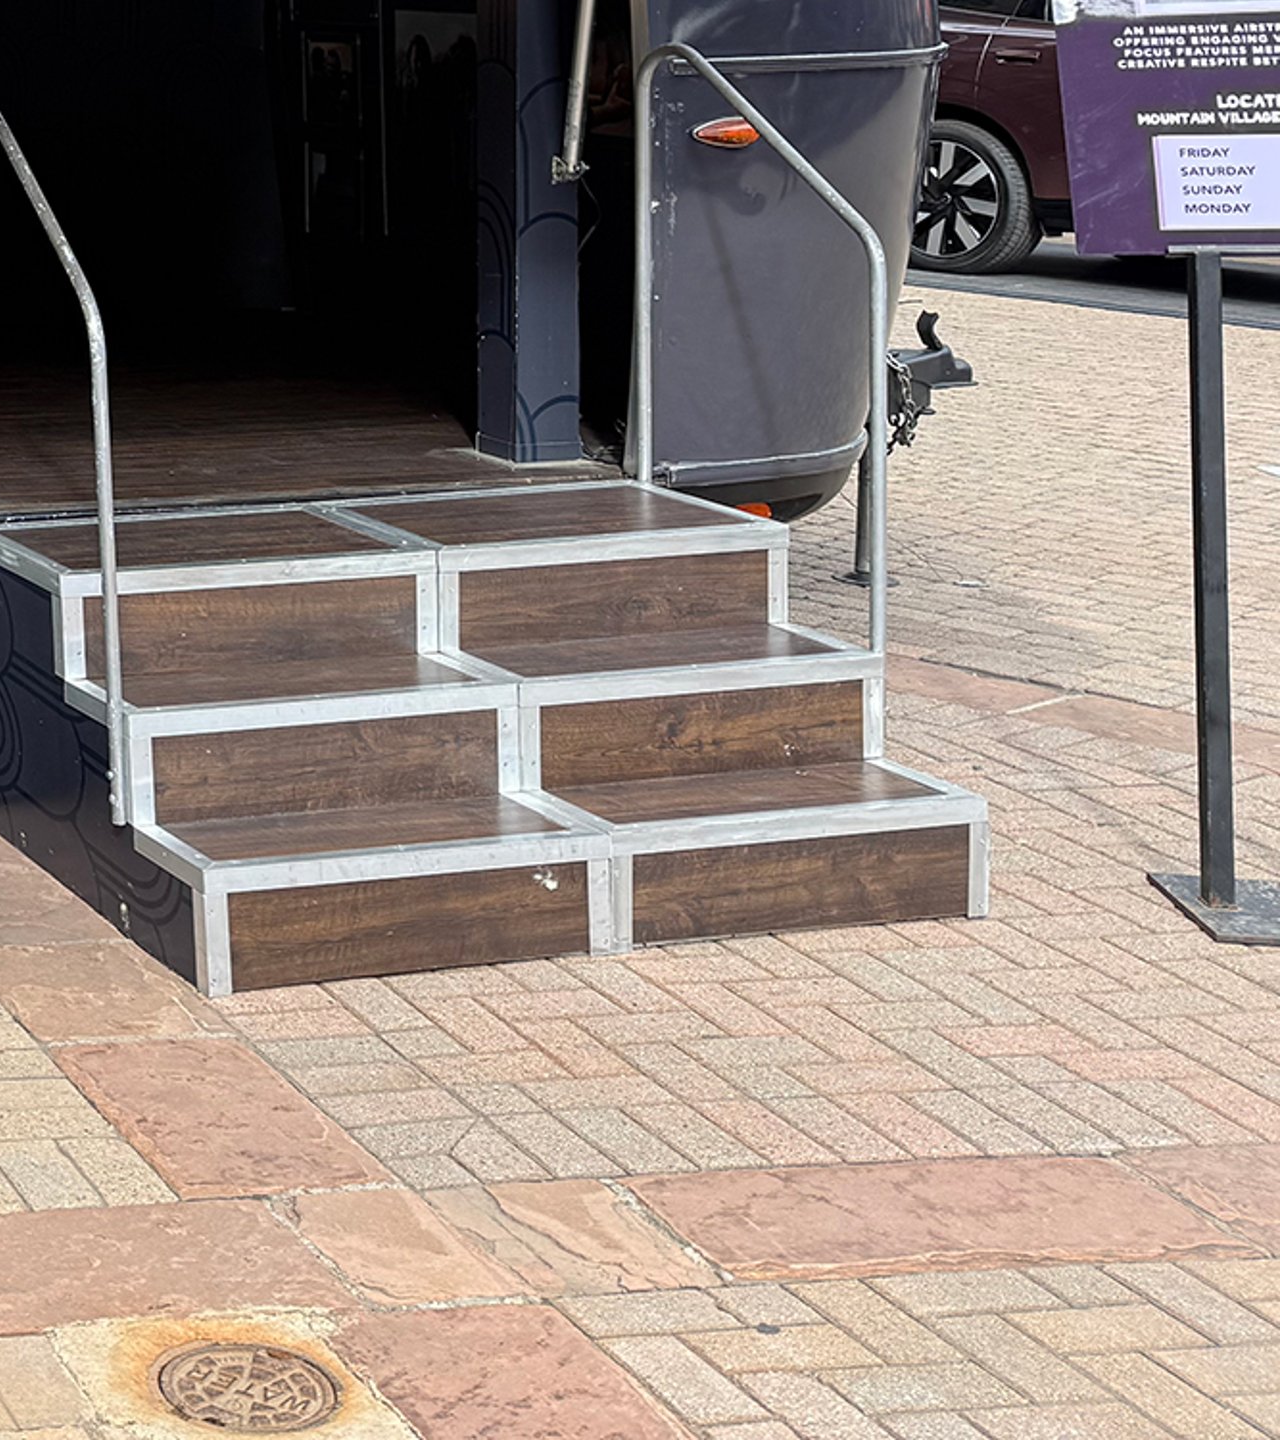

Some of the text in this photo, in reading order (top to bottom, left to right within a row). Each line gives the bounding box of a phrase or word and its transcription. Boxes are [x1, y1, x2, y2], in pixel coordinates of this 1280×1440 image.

[1123, 26, 1144, 36] AN
[1149, 24, 1228, 35] IMMERSIVE
[1113, 36, 1186, 48] OFFERING
[1191, 34, 1268, 45] ENGAGING
[1124, 48, 1171, 58] FOCUS
[1176, 46, 1247, 57] FEATURES
[1117, 58, 1185, 70] CREATIVE
[1191, 57, 1248, 68] RESPITE
[1137, 111, 1280, 126] MOUNTAIN VILLAGE
[1179, 148, 1230, 158] FRIDAY
[1180, 166, 1256, 177] SATURDAY
[1182, 184, 1242, 195] SUNDAY
[1184, 203, 1251, 214] MONDAY
